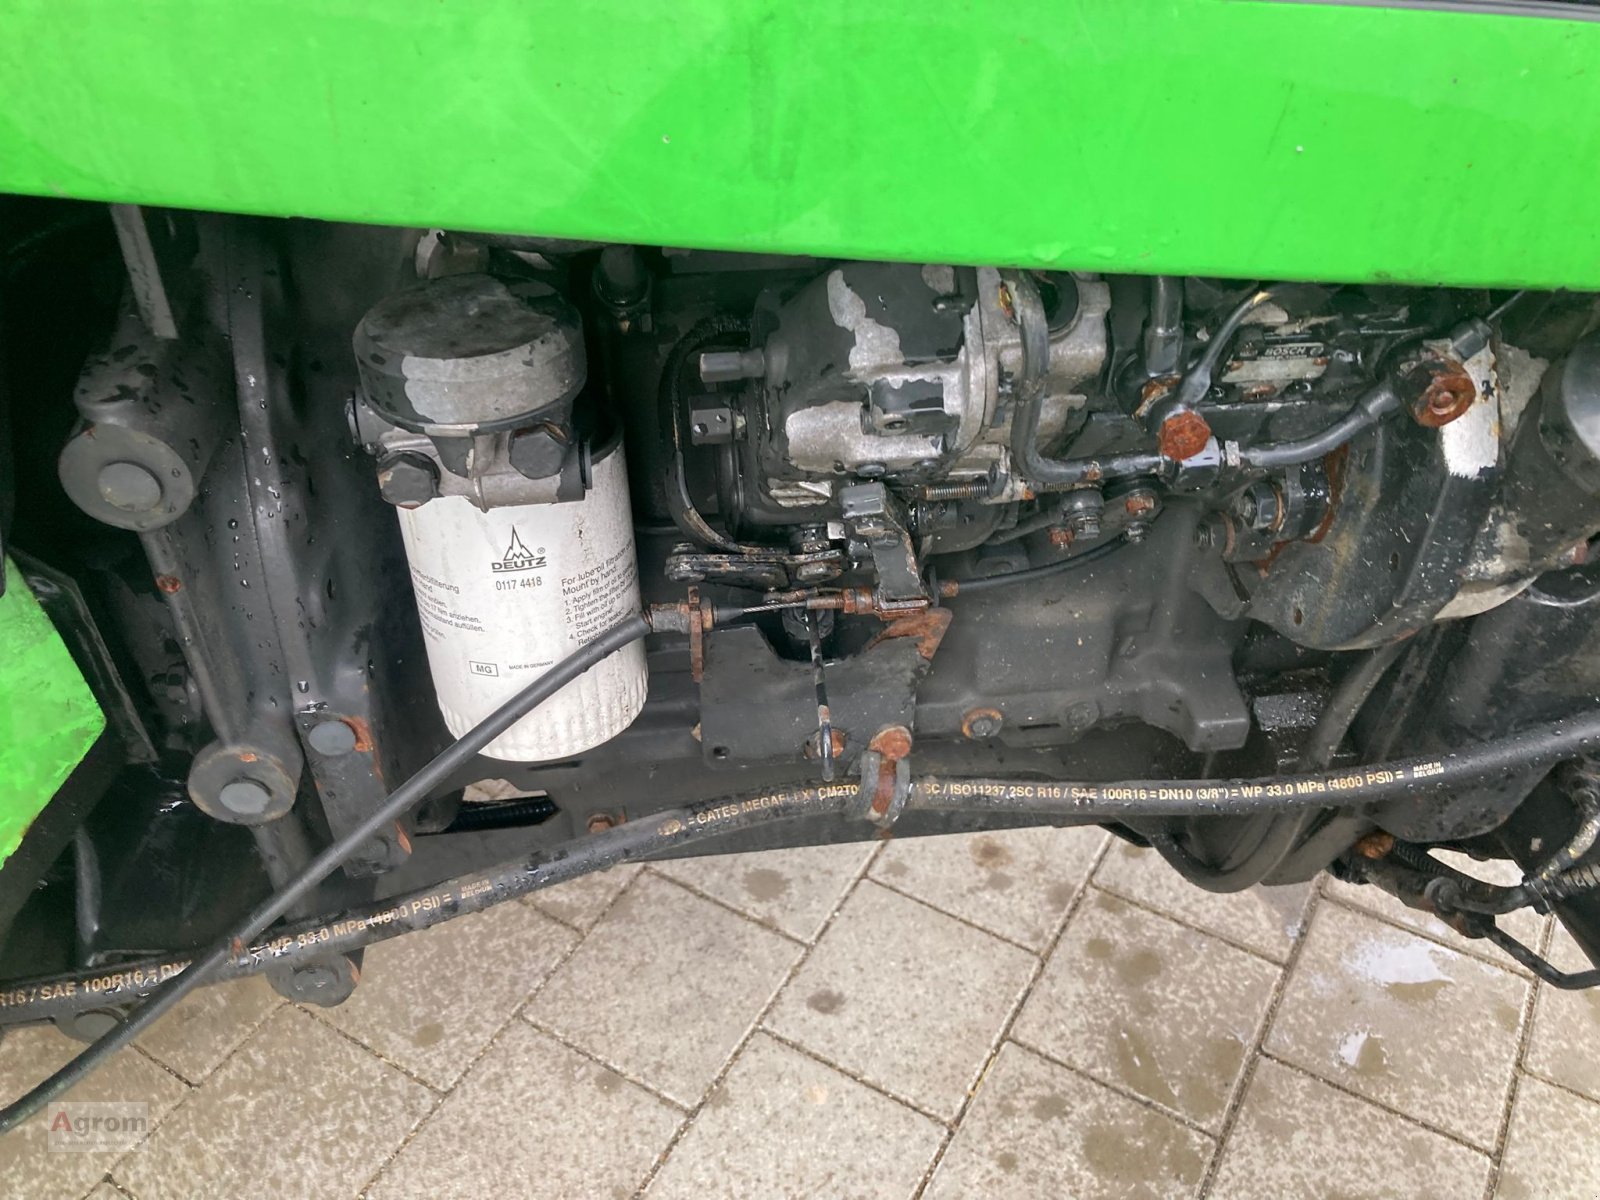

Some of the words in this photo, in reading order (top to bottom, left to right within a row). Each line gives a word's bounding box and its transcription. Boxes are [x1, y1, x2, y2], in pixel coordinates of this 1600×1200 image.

[491, 556, 547, 570] DEUTZ
[495, 580, 517, 591] 0117
[520, 576, 542, 589] 4418
[561, 577, 576, 587] For
[562, 580, 589, 597] Mount
[590, 577, 600, 586] by
[572, 592, 592, 605] Apply
[574, 597, 598, 613] Tighten
[575, 612, 585, 620] Fill
[586, 605, 599, 616] with
[575, 618, 593, 630] Start
[576, 625, 598, 638] Check
[476, 664, 492, 674] MG
[530, 660, 553, 668] GERMANY
[1413, 764, 1433, 772] MADE
[1434, 761, 1441, 769] IN
[1413, 768, 1445, 779] BELGIUM
[950, 785, 1006, 796] ISO11237
[1009, 786, 1034, 798] 2SC
[1038, 786, 1060, 799] R16
[1071, 788, 1098, 799] SAE
[1102, 788, 1147, 799] 100R16
[1159, 788, 1193, 800] DN10
[1196, 787, 1229, 800] (3/8")
[1241, 786, 1263, 798] WP
[1267, 783, 1293, 797] 33.0
[1297, 781, 1326, 794] MPa
[1328, 776, 1363, 791] (4800
[1367, 771, 1393, 785] PSI)
[696, 804, 739, 825] GATES
[461, 882, 480, 892] MADE
[461, 886, 493, 899] BELGIUM
[332, 919, 366, 937] MPa
[412, 895, 441, 914] PSI)
[40, 981, 77, 1001] SAE
[82, 970, 144, 994] 100R16
